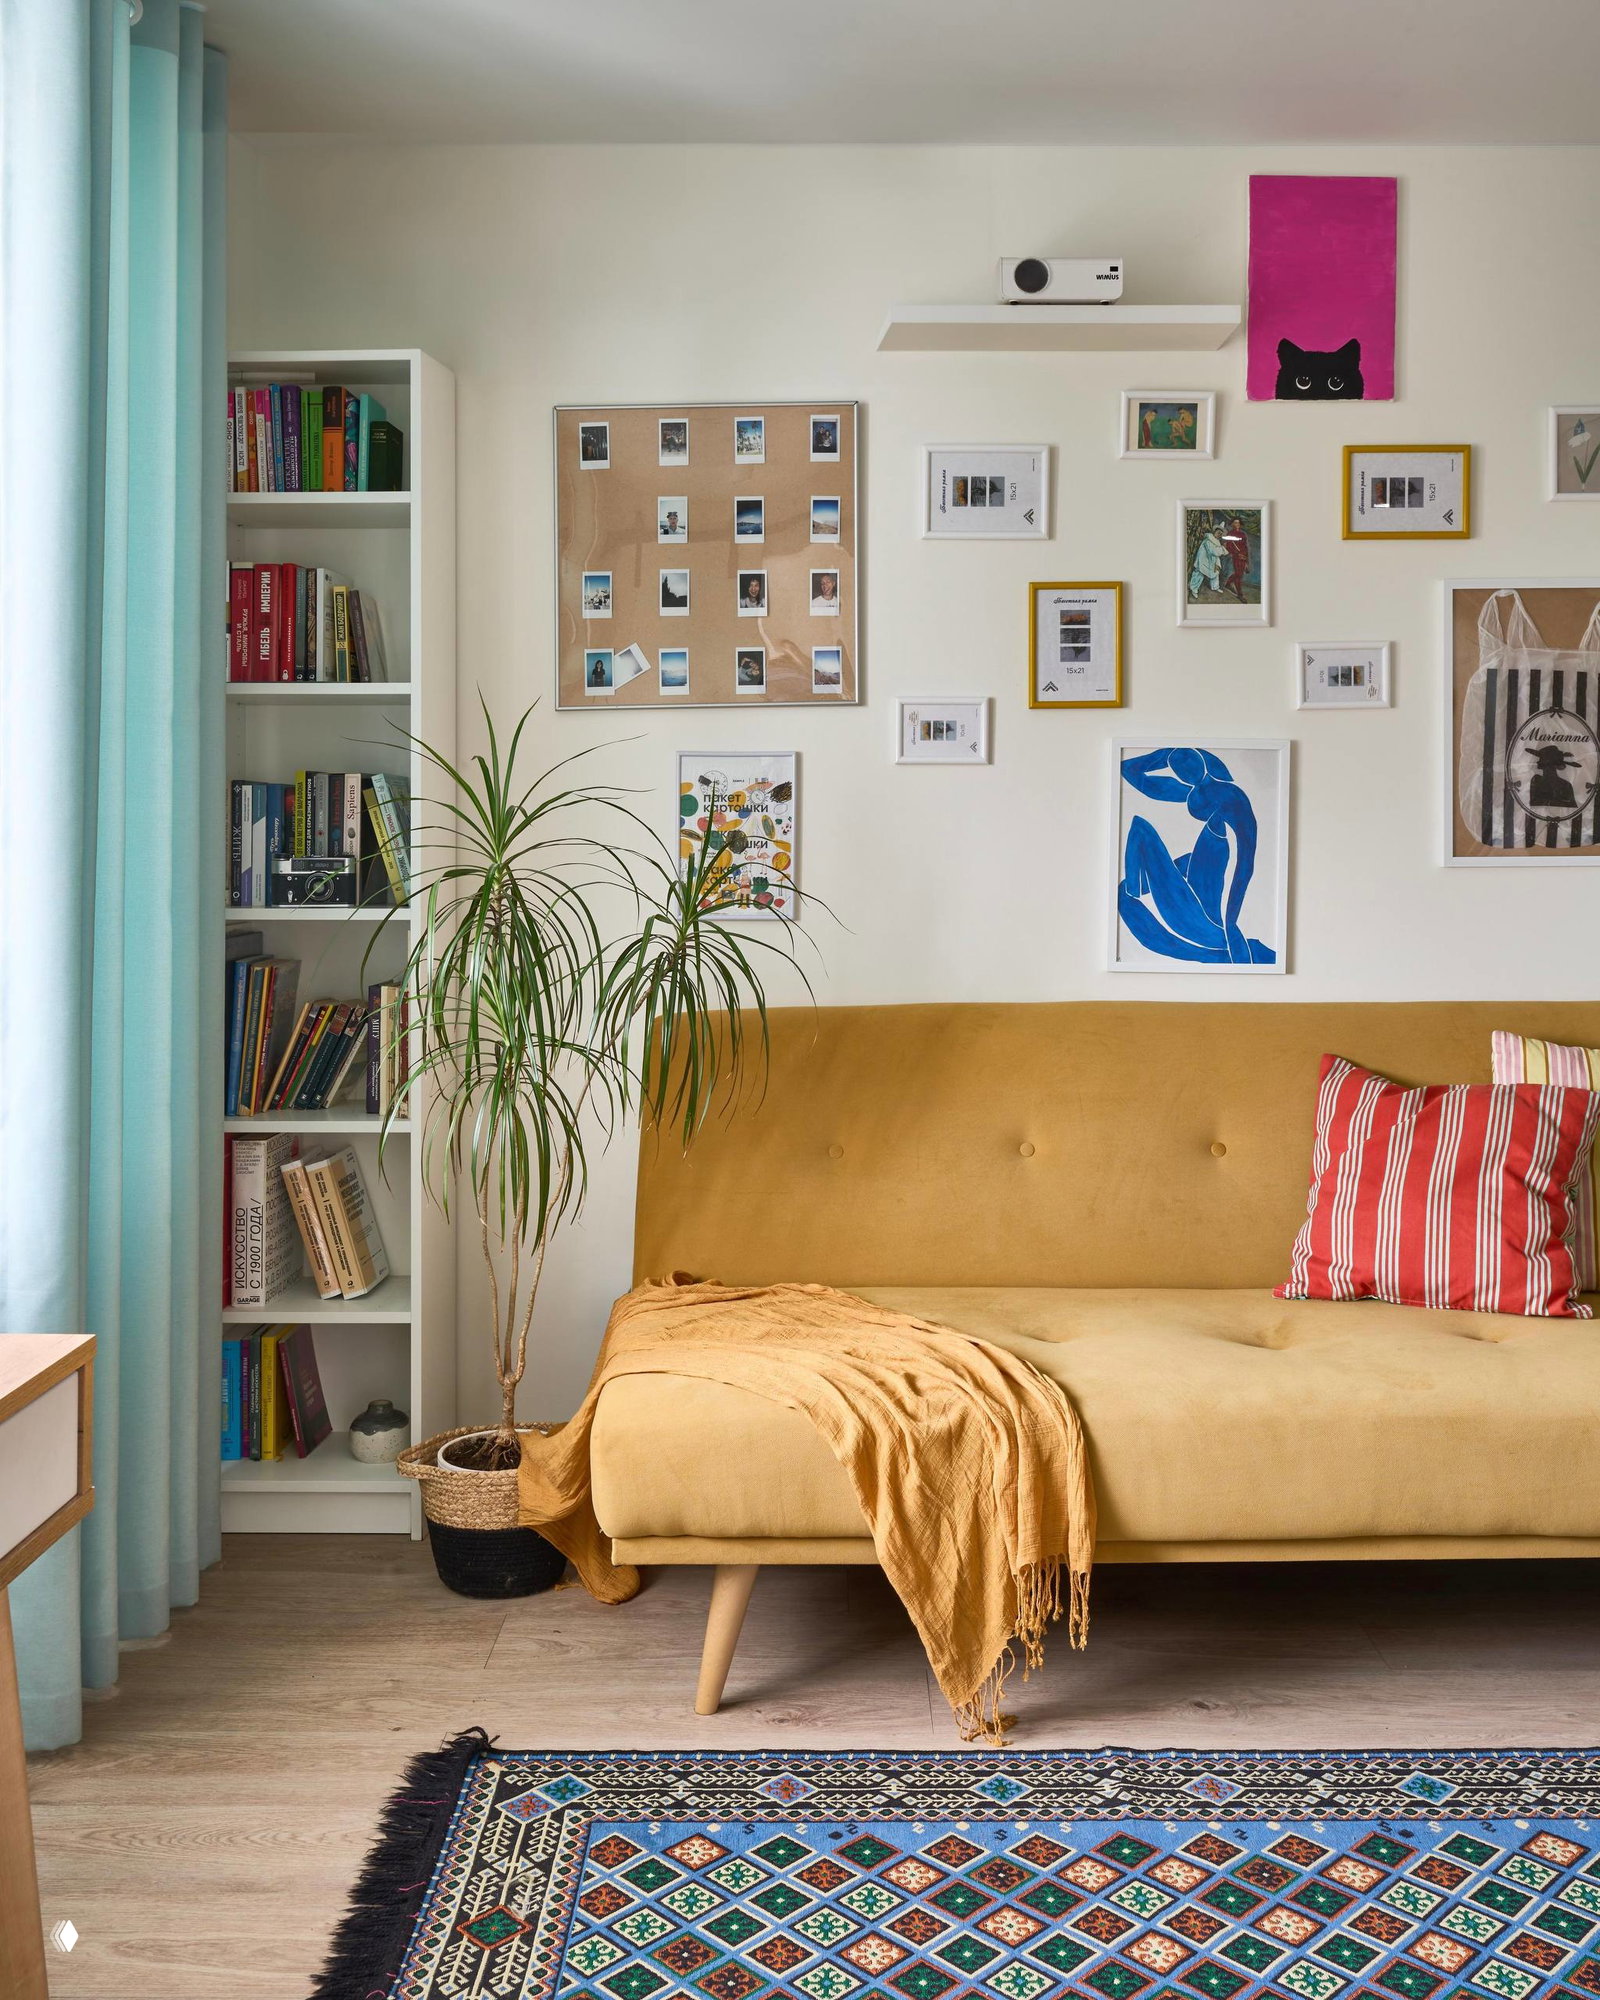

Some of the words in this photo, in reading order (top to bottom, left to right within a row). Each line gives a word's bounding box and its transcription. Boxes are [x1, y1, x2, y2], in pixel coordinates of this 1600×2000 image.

[261, 571, 271, 613] ИМПЕРИИ
[336, 595, 344, 624] БОДРИЙЯР
[260, 627, 270, 660] ГИБЕЛЬ
[1520, 727, 1590, 743] Marianna
[347, 784, 356, 820] Sapiens
[704, 794, 741, 803] пакет
[704, 804, 768, 814] картошки
[232, 826, 241, 862] ЖИТЬ!
[372, 1019, 380, 1039] МПГУ
[235, 1208, 246, 1288] ИСКУССТВО
[250, 1246, 260, 1274] 1900
[250, 1280, 260, 1288] С
